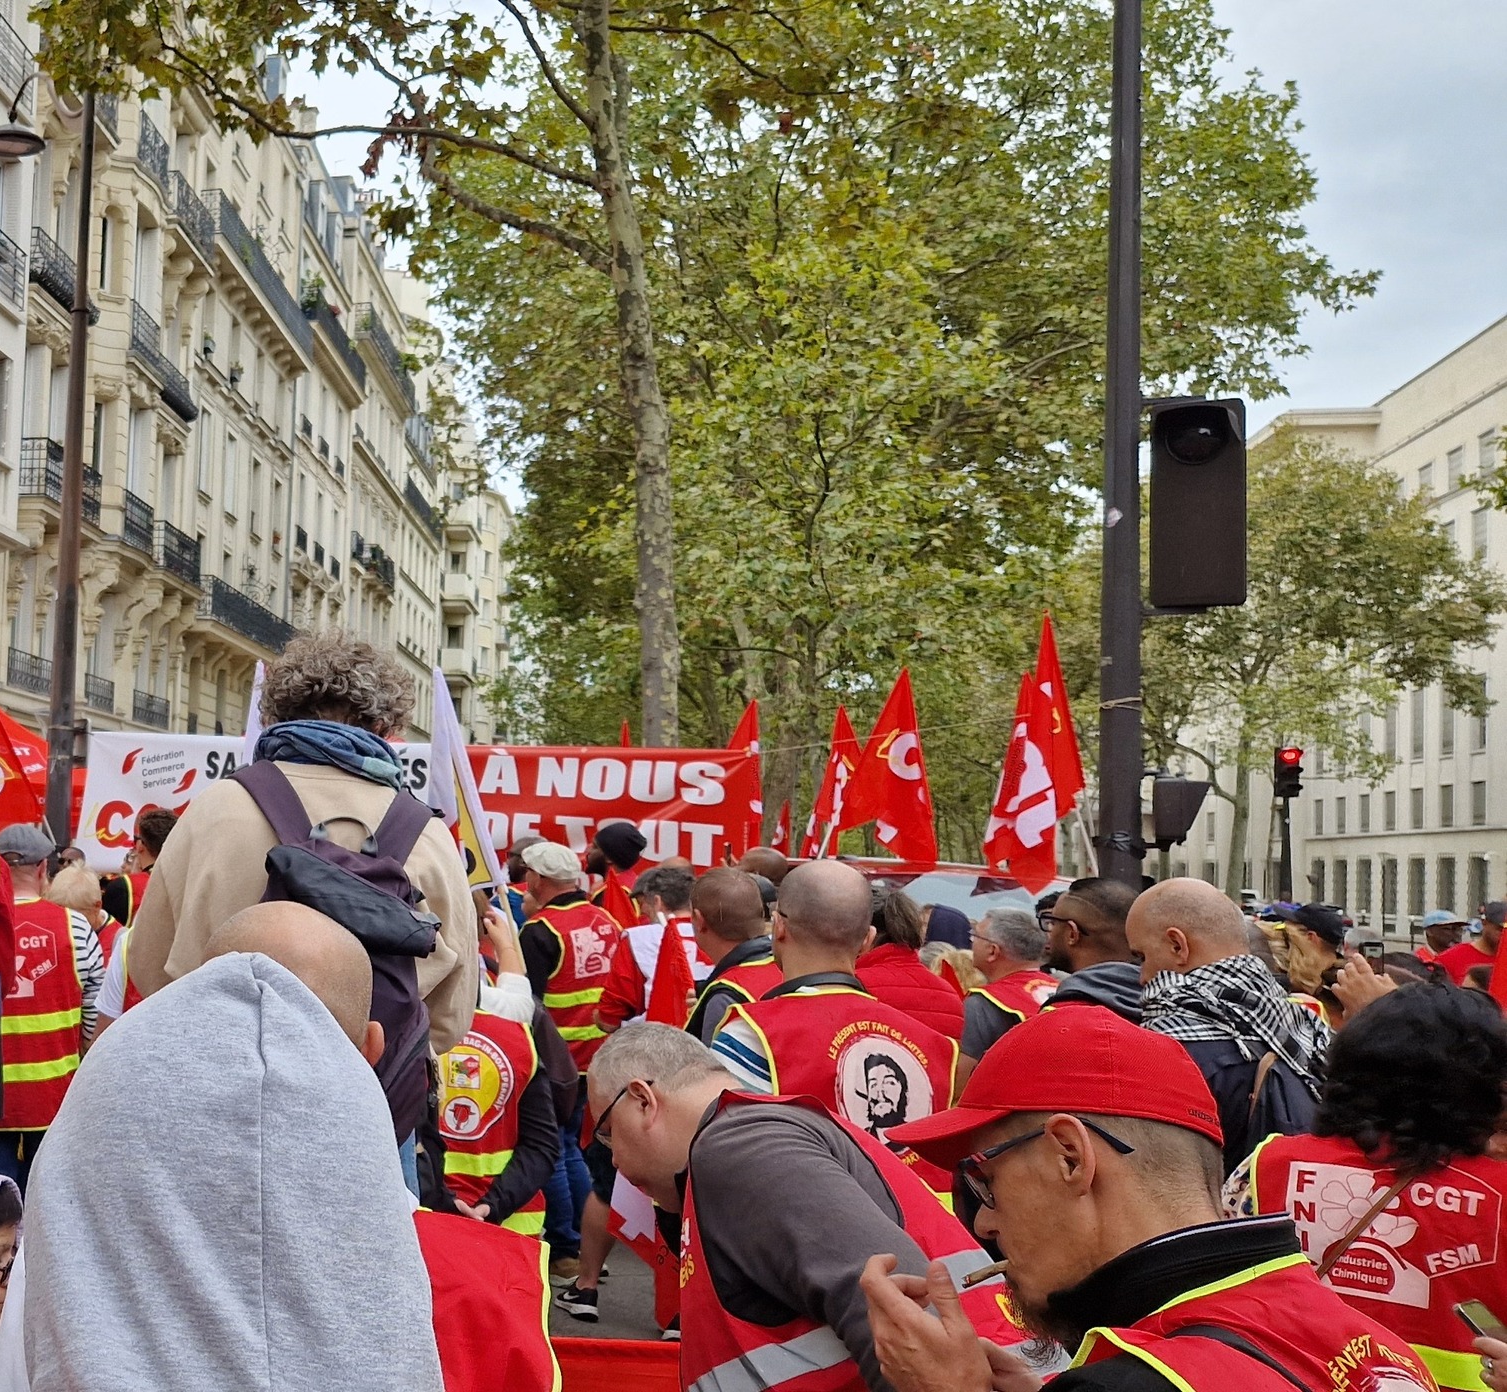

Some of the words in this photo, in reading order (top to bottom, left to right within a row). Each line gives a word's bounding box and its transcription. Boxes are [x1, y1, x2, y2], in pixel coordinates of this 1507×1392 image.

[141, 750, 185, 765] Fédération
[141, 762, 185, 777] Commerce
[479, 748, 520, 795] À
[536, 756, 726, 806] NOUS
[142, 776, 176, 789] Services
[556, 815, 724, 867] TUT
[19, 935, 49, 949] CGT
[31, 959, 53, 978] FSM
[827, 1047, 838, 1060] LE
[857, 1021, 871, 1031] EST
[871, 1022, 890, 1034] FAIT
[890, 1029, 902, 1040] DE
[1409, 1182, 1485, 1216] CGT
[1294, 1169, 1317, 1252] FNI
[1337, 1254, 1388, 1270] ndustries
[1425, 1244, 1482, 1274] FSM
[1332, 1268, 1389, 1285] Chimiques
